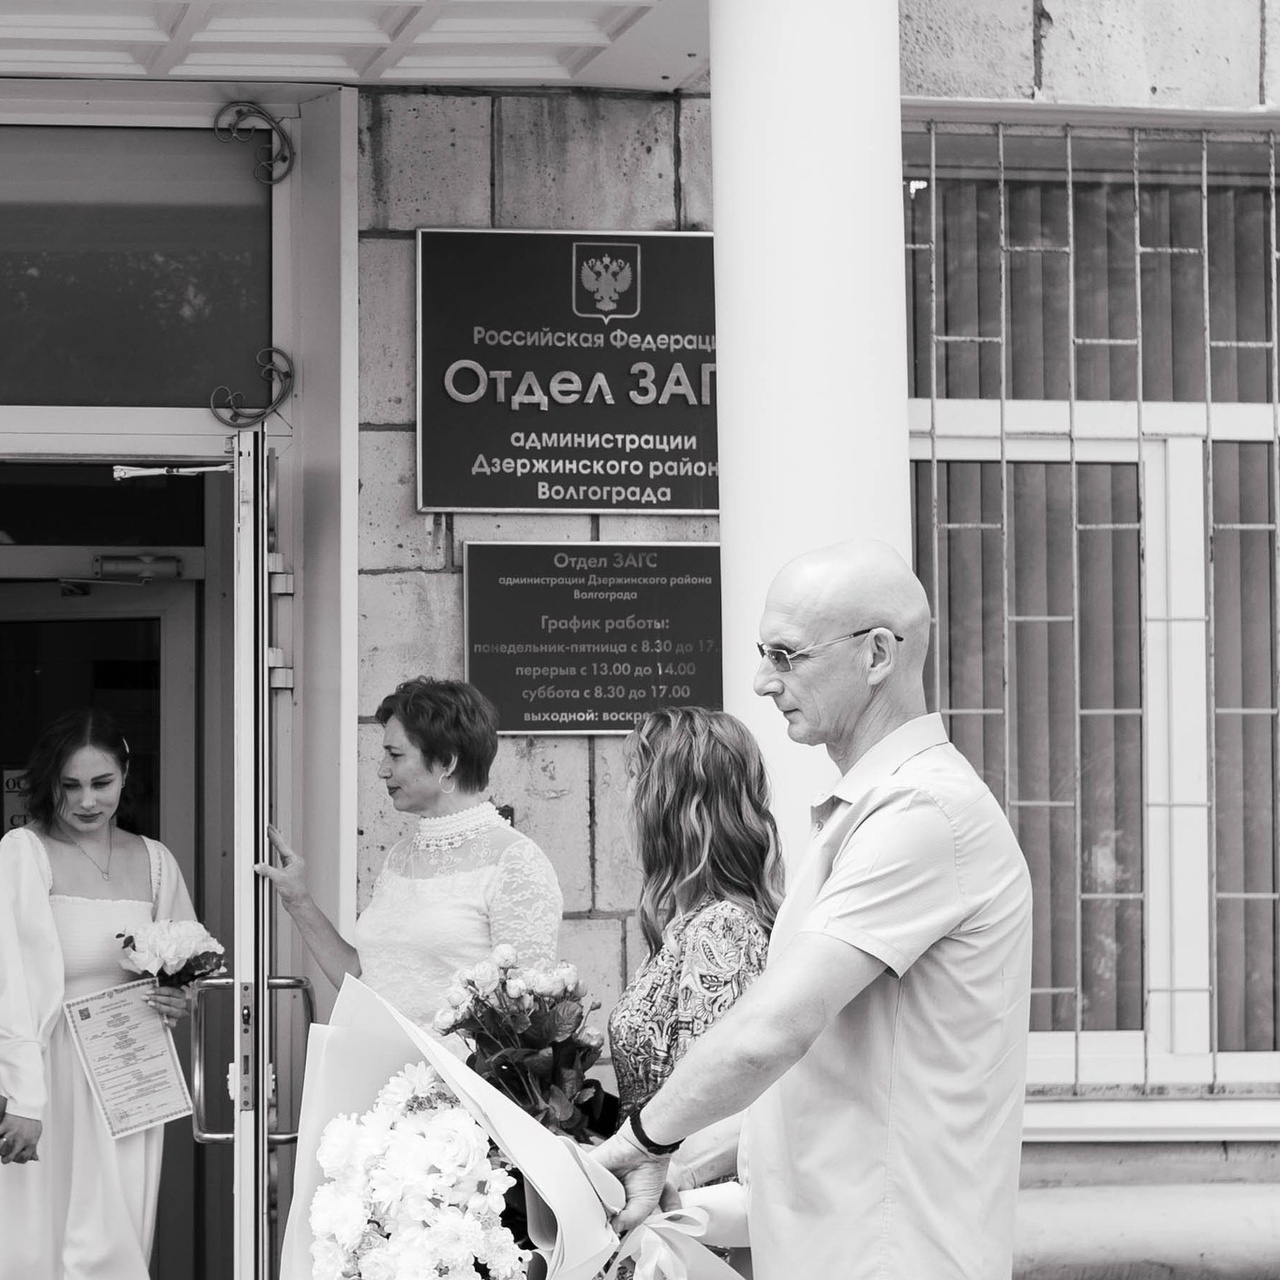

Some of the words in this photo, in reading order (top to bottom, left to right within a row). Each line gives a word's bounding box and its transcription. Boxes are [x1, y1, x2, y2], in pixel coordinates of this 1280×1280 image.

[474, 326, 604, 347] Российская
[444, 360, 615, 411] Отдел
[511, 432, 696, 452] администрации
[472, 454, 643, 476] Дзержинского
[538, 482, 671, 503] Волгограда
[553, 553, 608, 571] Отдел
[612, 553, 658, 568] ЗАГС
[498, 576, 585, 586] администрации
[587, 575, 668, 587] Дзержинского
[669, 575, 712, 587] района
[573, 590, 638, 602] Волгограда
[541, 616, 601, 634] График
[605, 615, 670, 633] работы:
[473, 643, 627, 654] понедельник-пятница
[630, 644, 638, 653] с
[641, 640, 672, 653] 8.30
[515, 667, 577, 680] перерыв
[580, 667, 587, 676] с
[592, 663, 631, 676] 13.00
[633, 667, 653, 677] до
[656, 663, 696, 675] 14.00
[522, 686, 580, 702] суббота
[583, 690, 591, 699] с
[593, 686, 625, 699] 8.30
[628, 690, 647, 700] до
[651, 685, 691, 698] 17.00
[524, 710, 599, 722] выходной:
